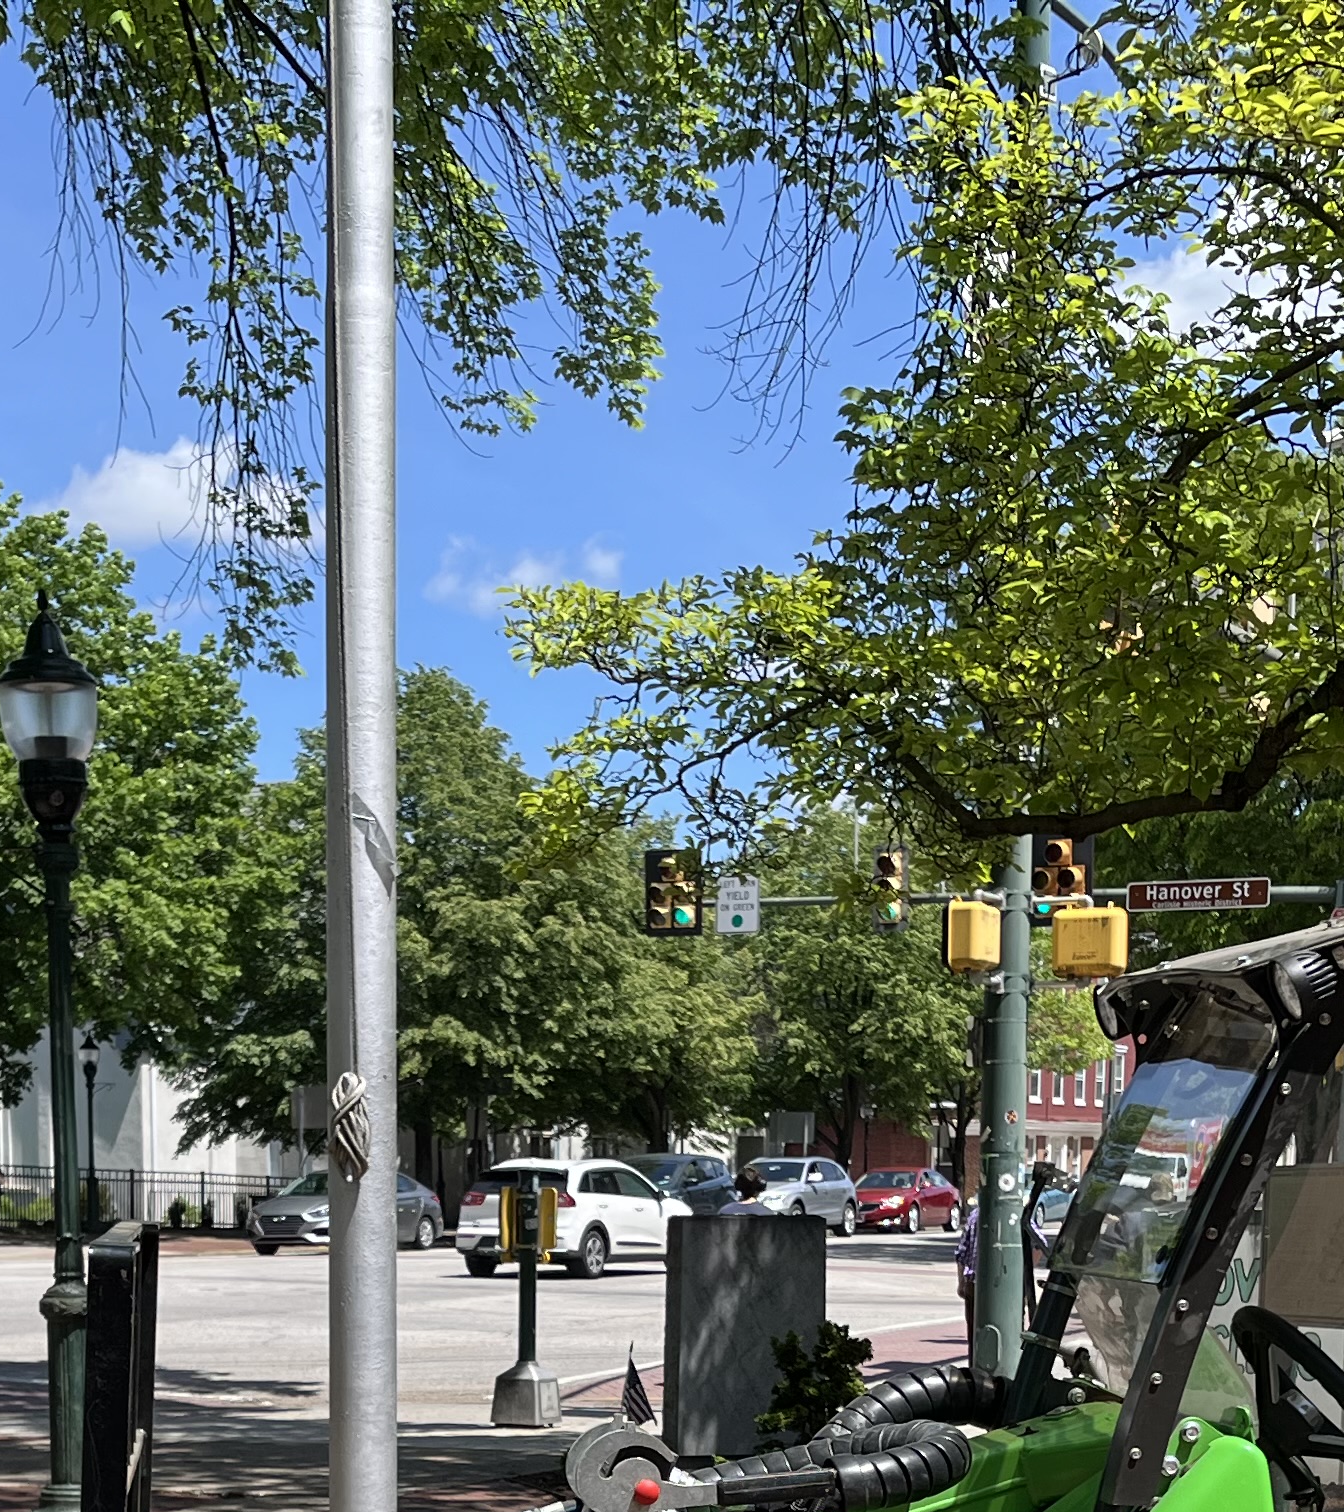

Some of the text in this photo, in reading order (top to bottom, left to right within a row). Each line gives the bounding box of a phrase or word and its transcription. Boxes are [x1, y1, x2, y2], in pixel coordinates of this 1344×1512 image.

[727, 891, 749, 900] YIELD
[1146, 882, 1250, 900] Hanover St
